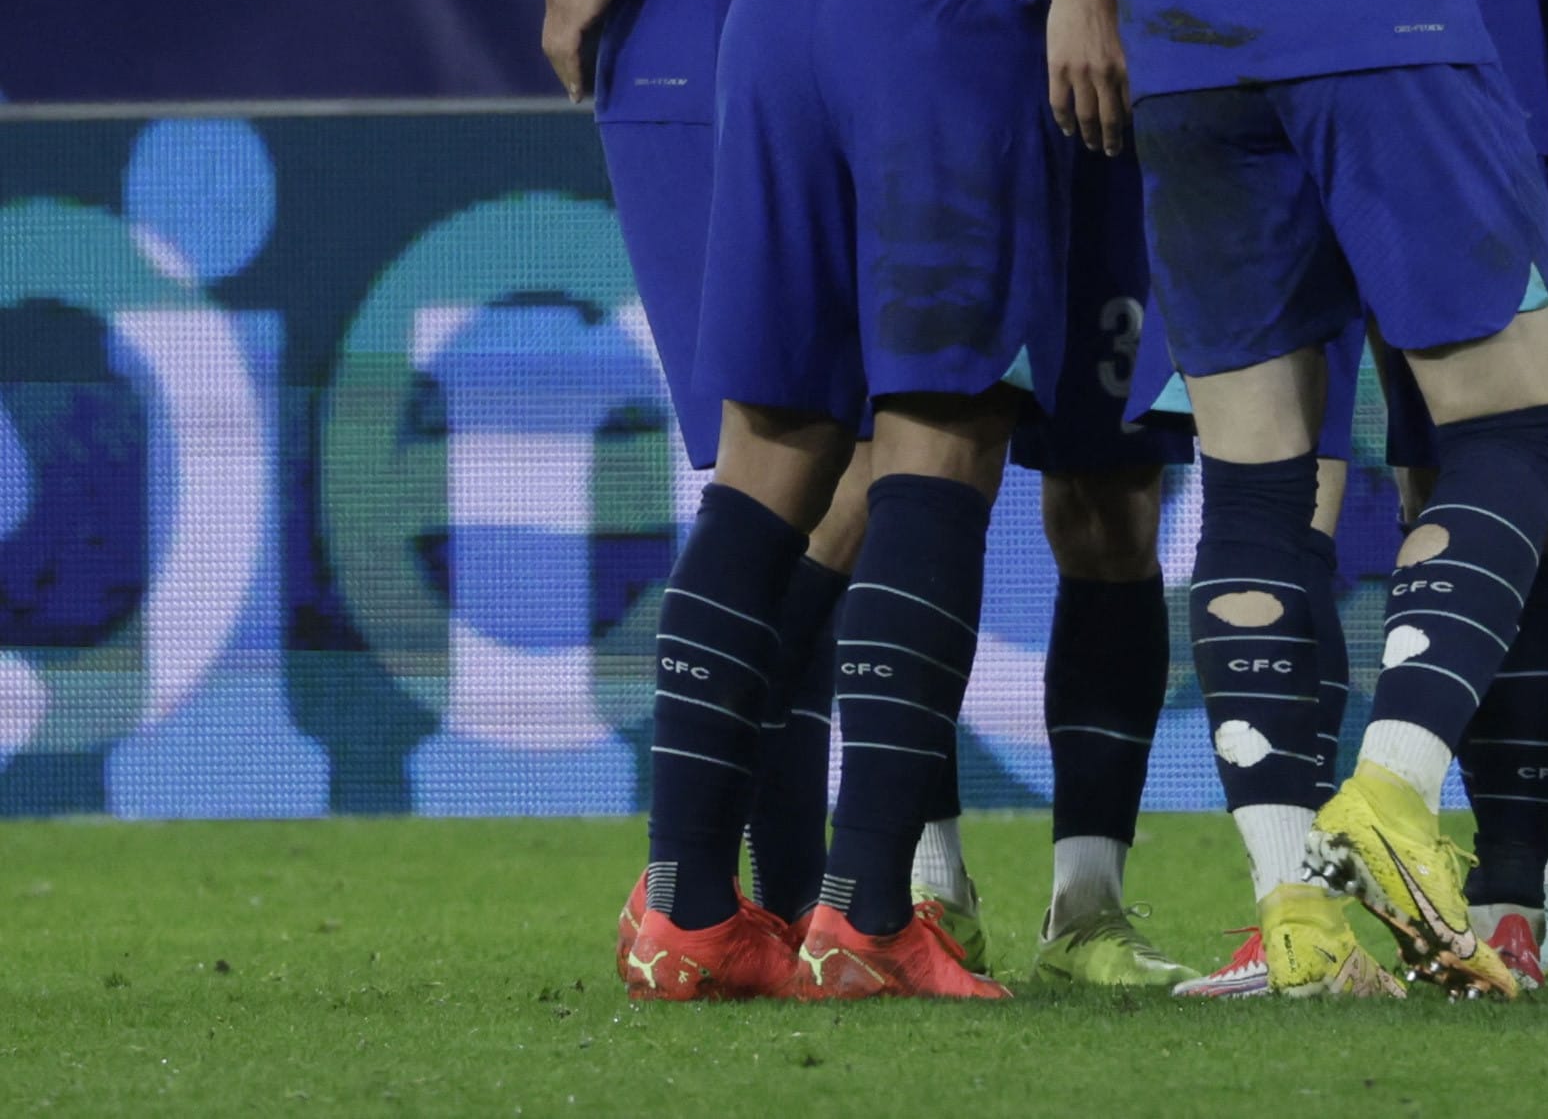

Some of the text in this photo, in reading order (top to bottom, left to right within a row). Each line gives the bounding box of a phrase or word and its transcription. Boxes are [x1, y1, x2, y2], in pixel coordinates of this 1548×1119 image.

[1392, 581, 1454, 595] CFC
[661, 657, 710, 679] CFC
[841, 662, 893, 677] CFC
[1228, 659, 1292, 674] CFC
